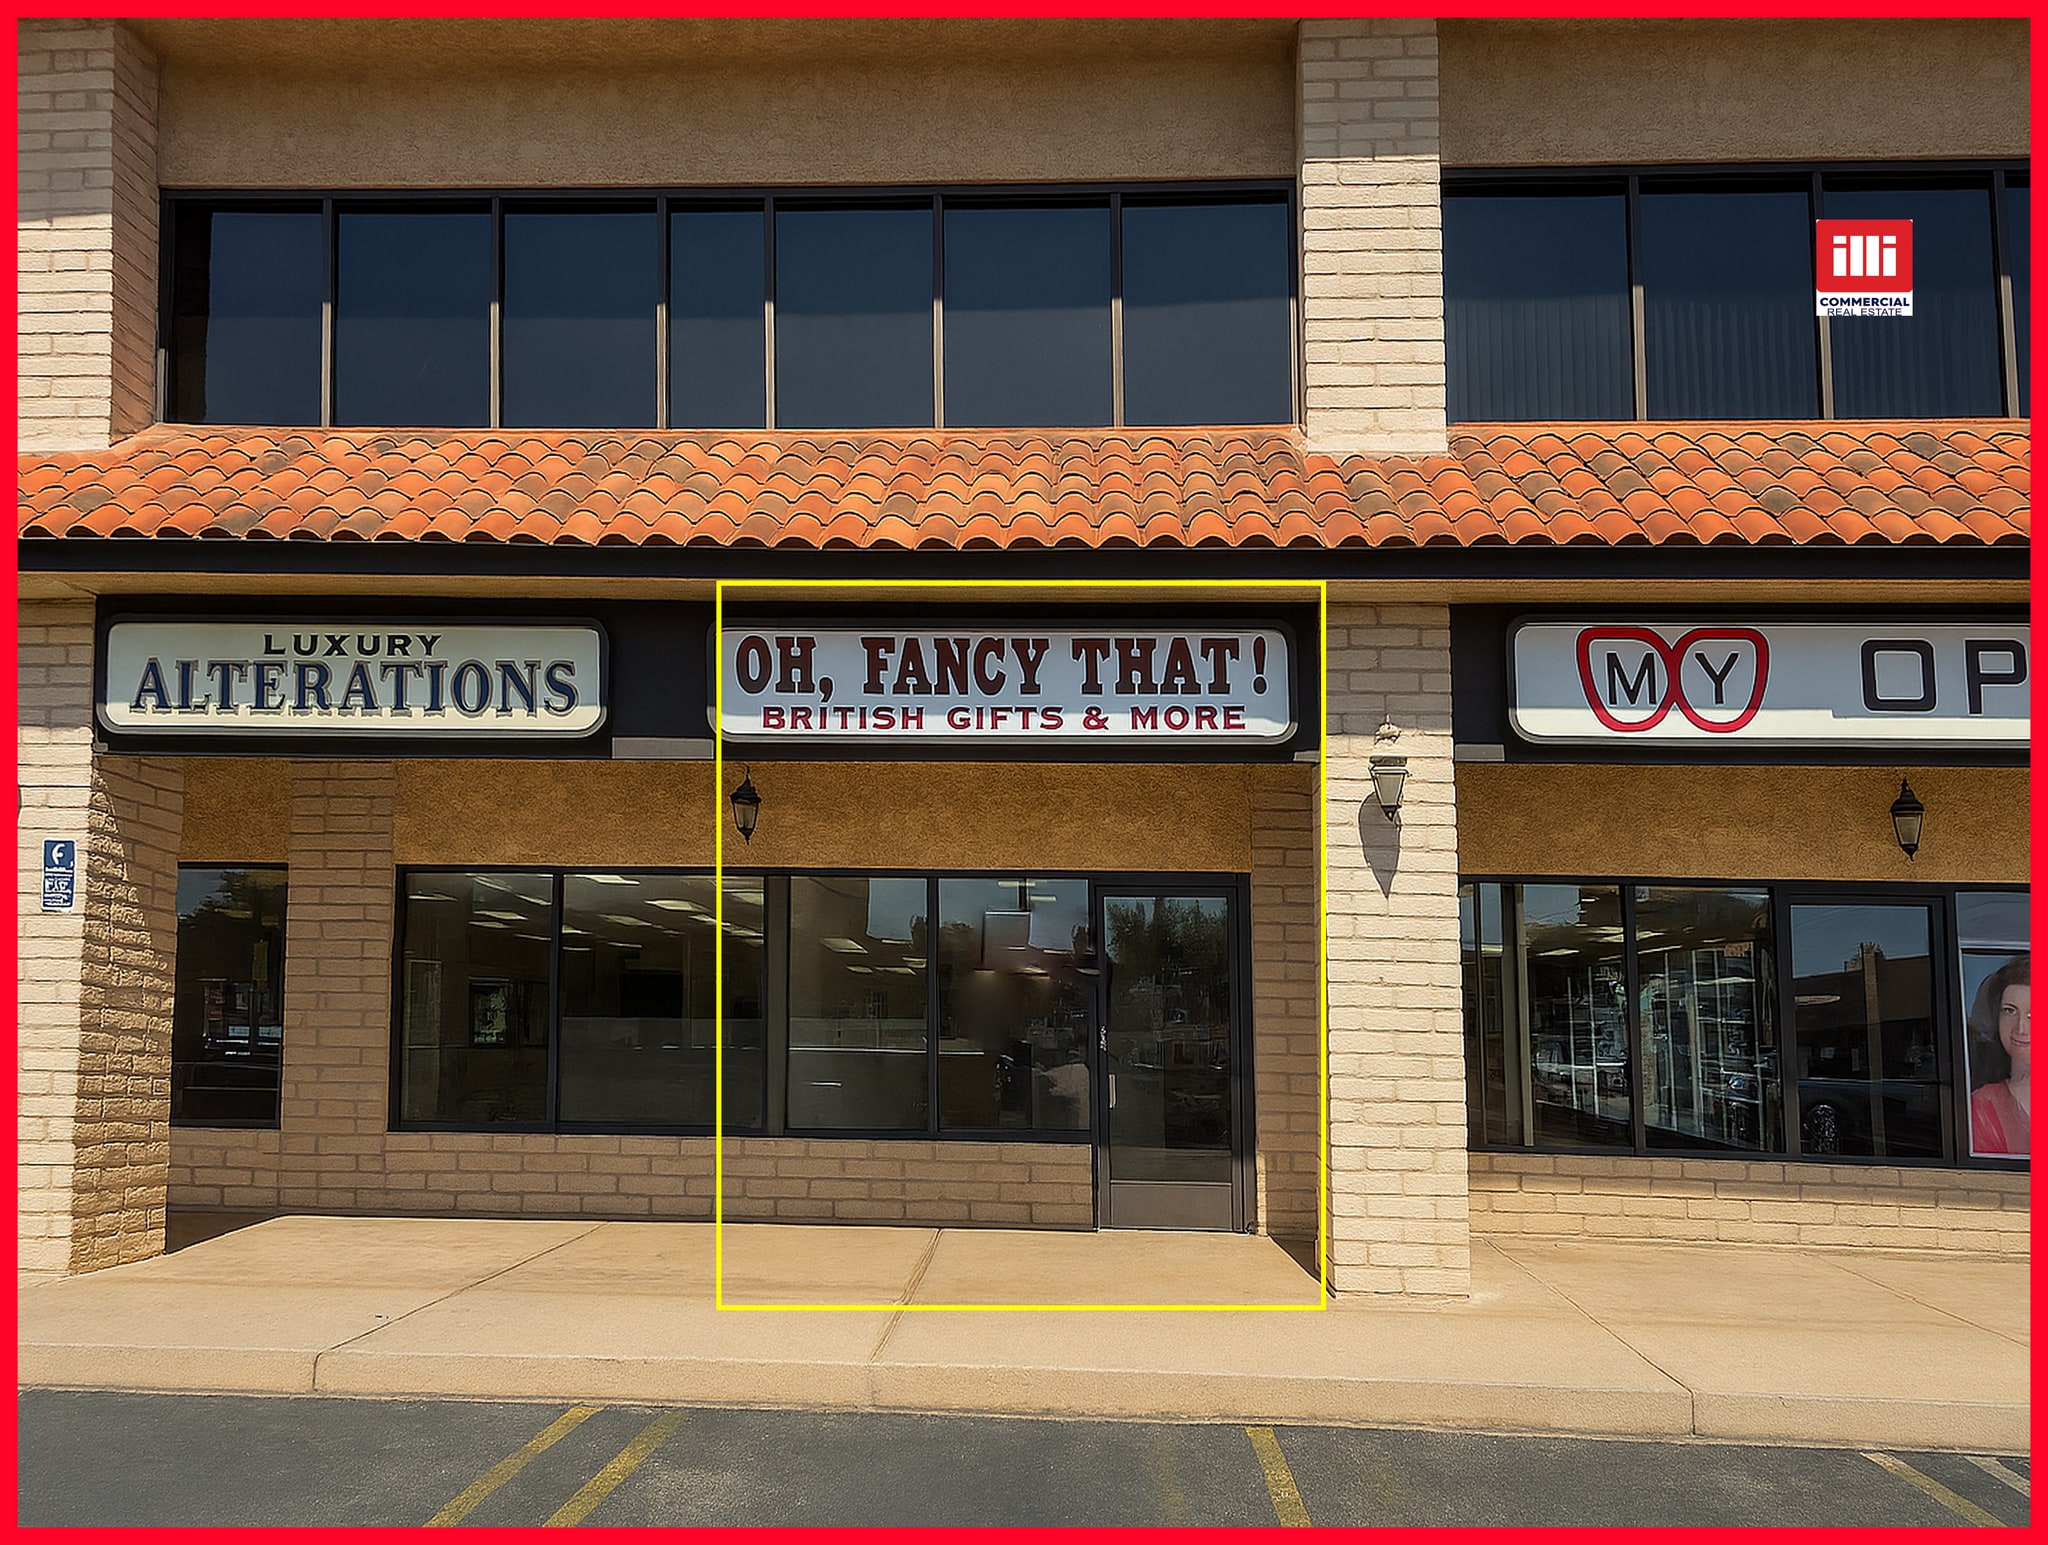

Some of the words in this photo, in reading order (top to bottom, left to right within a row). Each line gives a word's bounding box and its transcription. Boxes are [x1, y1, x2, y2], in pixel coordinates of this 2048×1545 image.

[264, 634, 443, 657] LUXURY
[736, 635, 834, 702] OH,
[861, 637, 1050, 696] FANCY
[129, 657, 581, 719] ALTERATIONS
[1605, 651, 1740, 706] MY
[762, 705, 925, 730] BRITISH
[947, 705, 1065, 730] GIFTS
[1083, 705, 1110, 730] &
[1130, 705, 1246, 731] MORE
